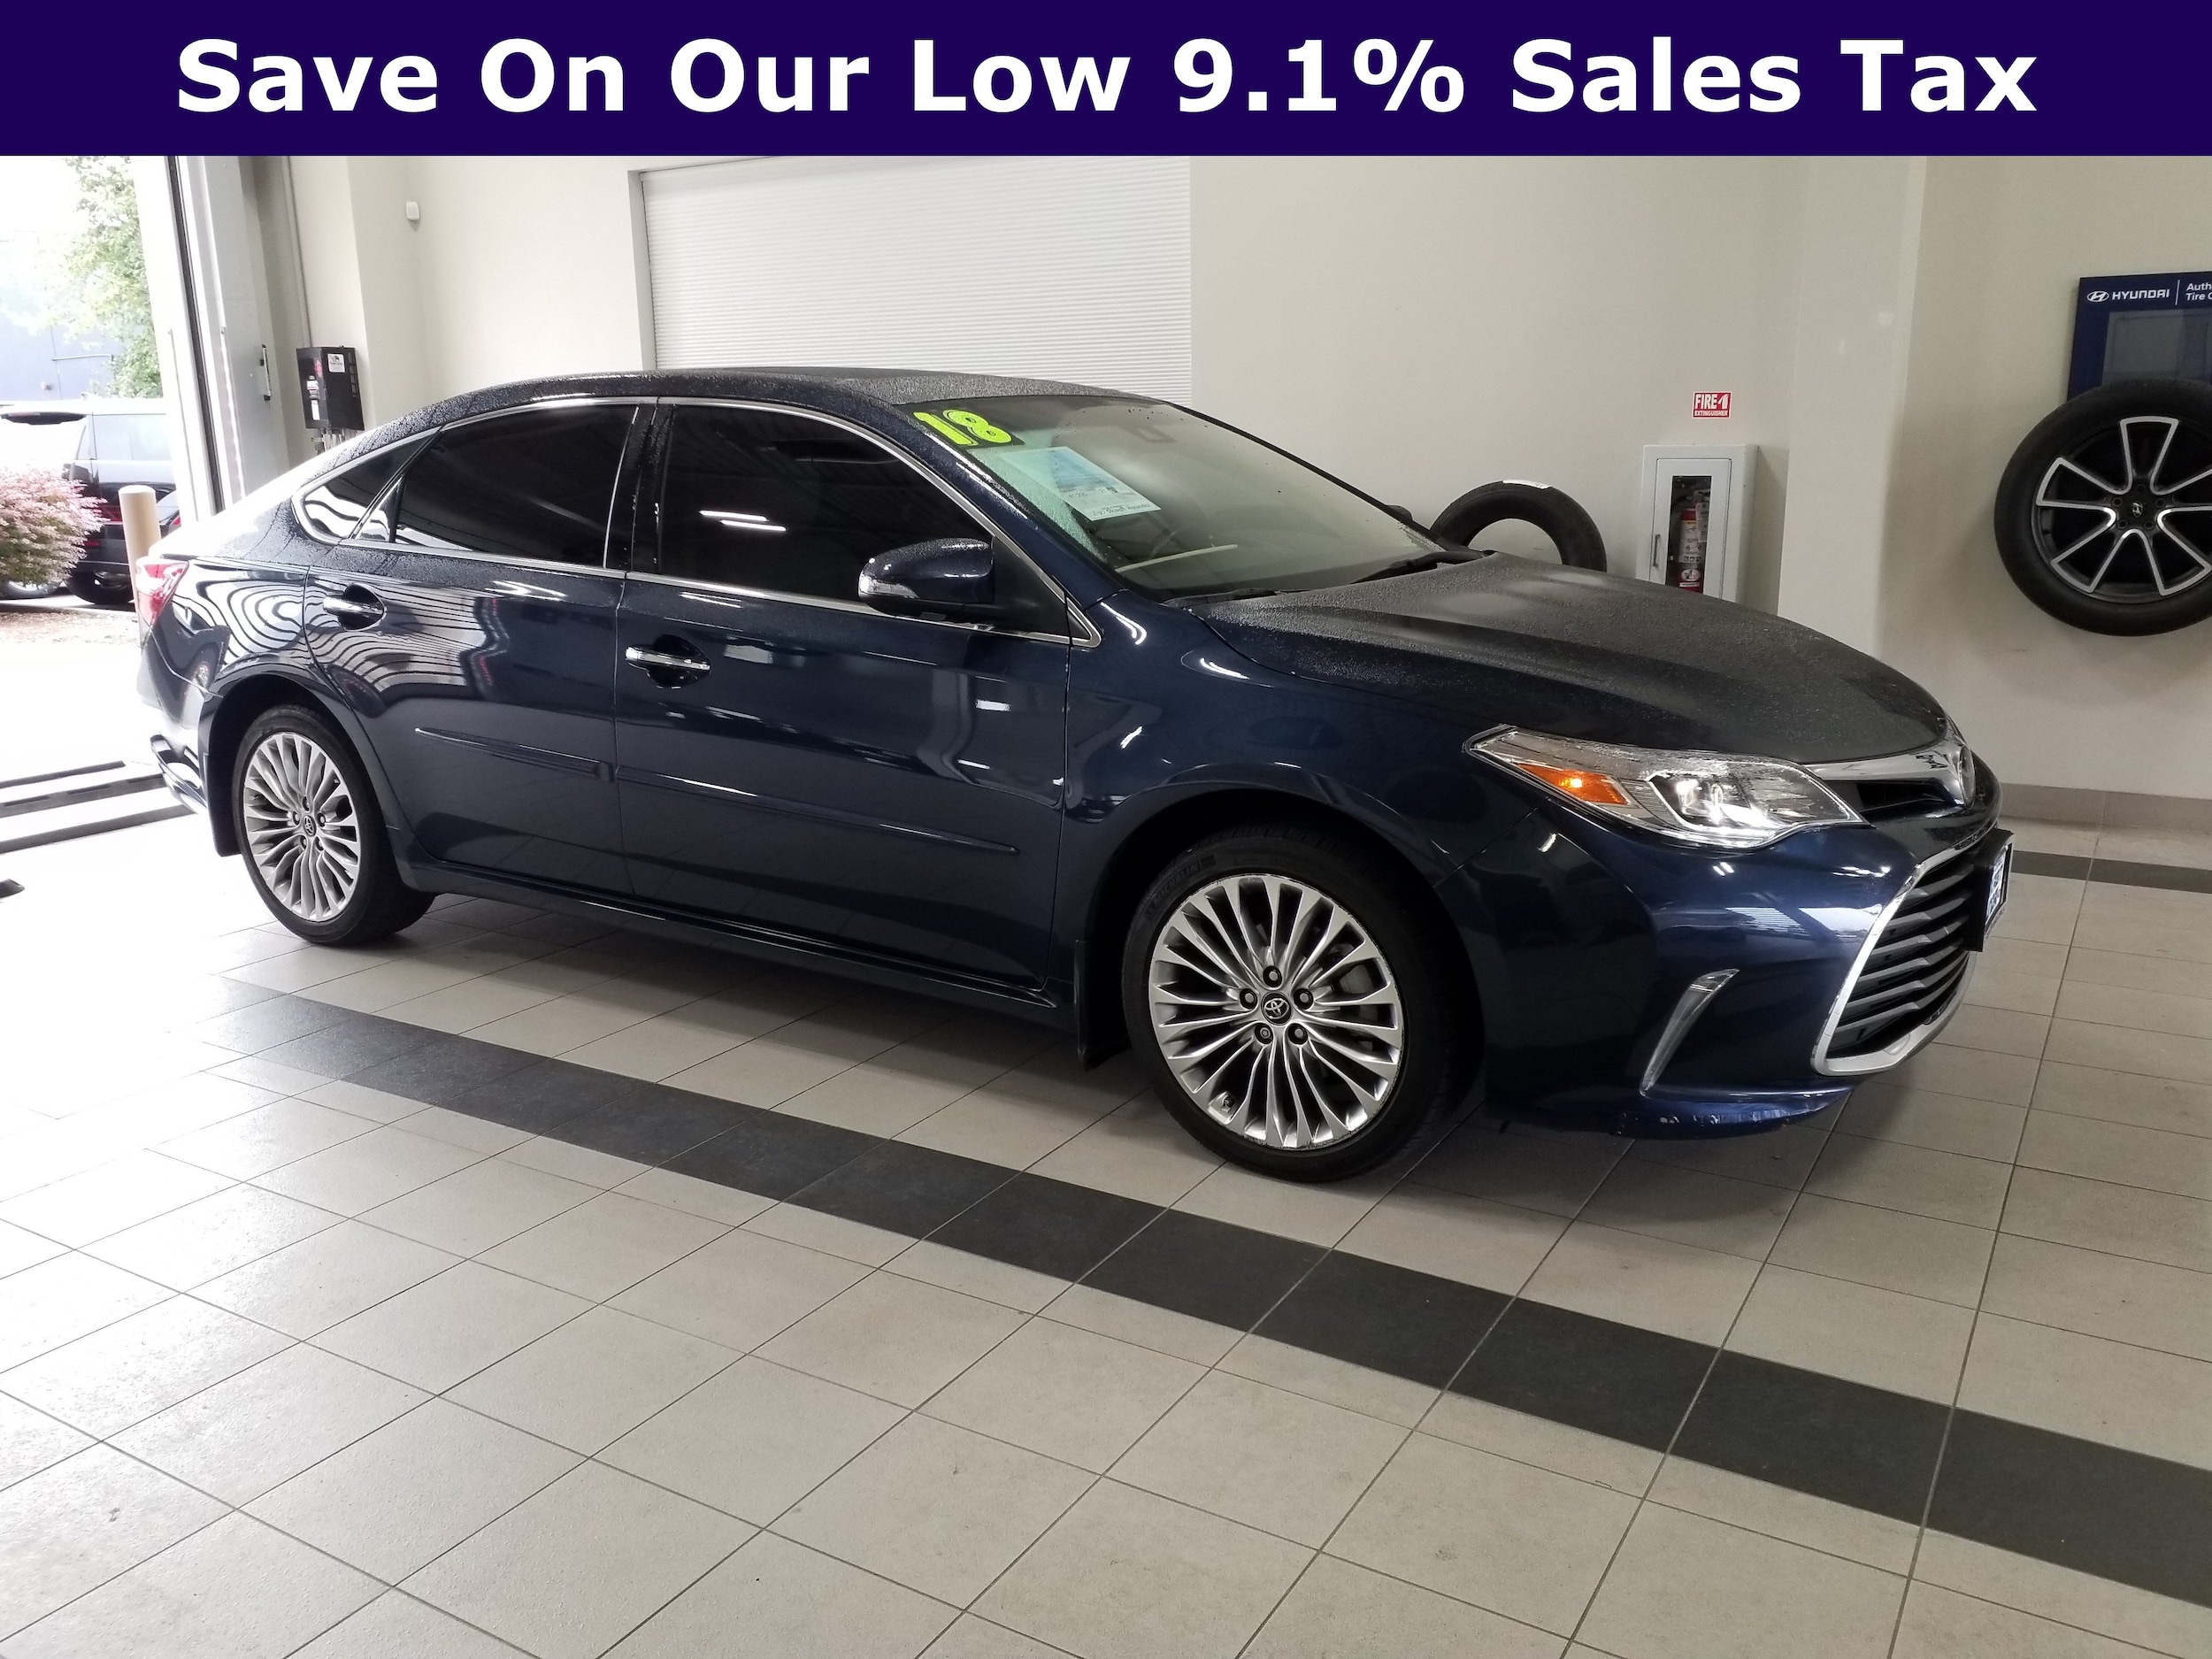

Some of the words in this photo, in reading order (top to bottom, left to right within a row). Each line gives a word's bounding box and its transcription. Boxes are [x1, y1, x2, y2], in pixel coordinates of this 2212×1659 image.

[2112, 289, 2170, 300] HYUNDAI
[2185, 292, 2206, 301] Tire
[1694, 394, 1718, 410] FIRE
[912, 409, 1013, 447] 18
